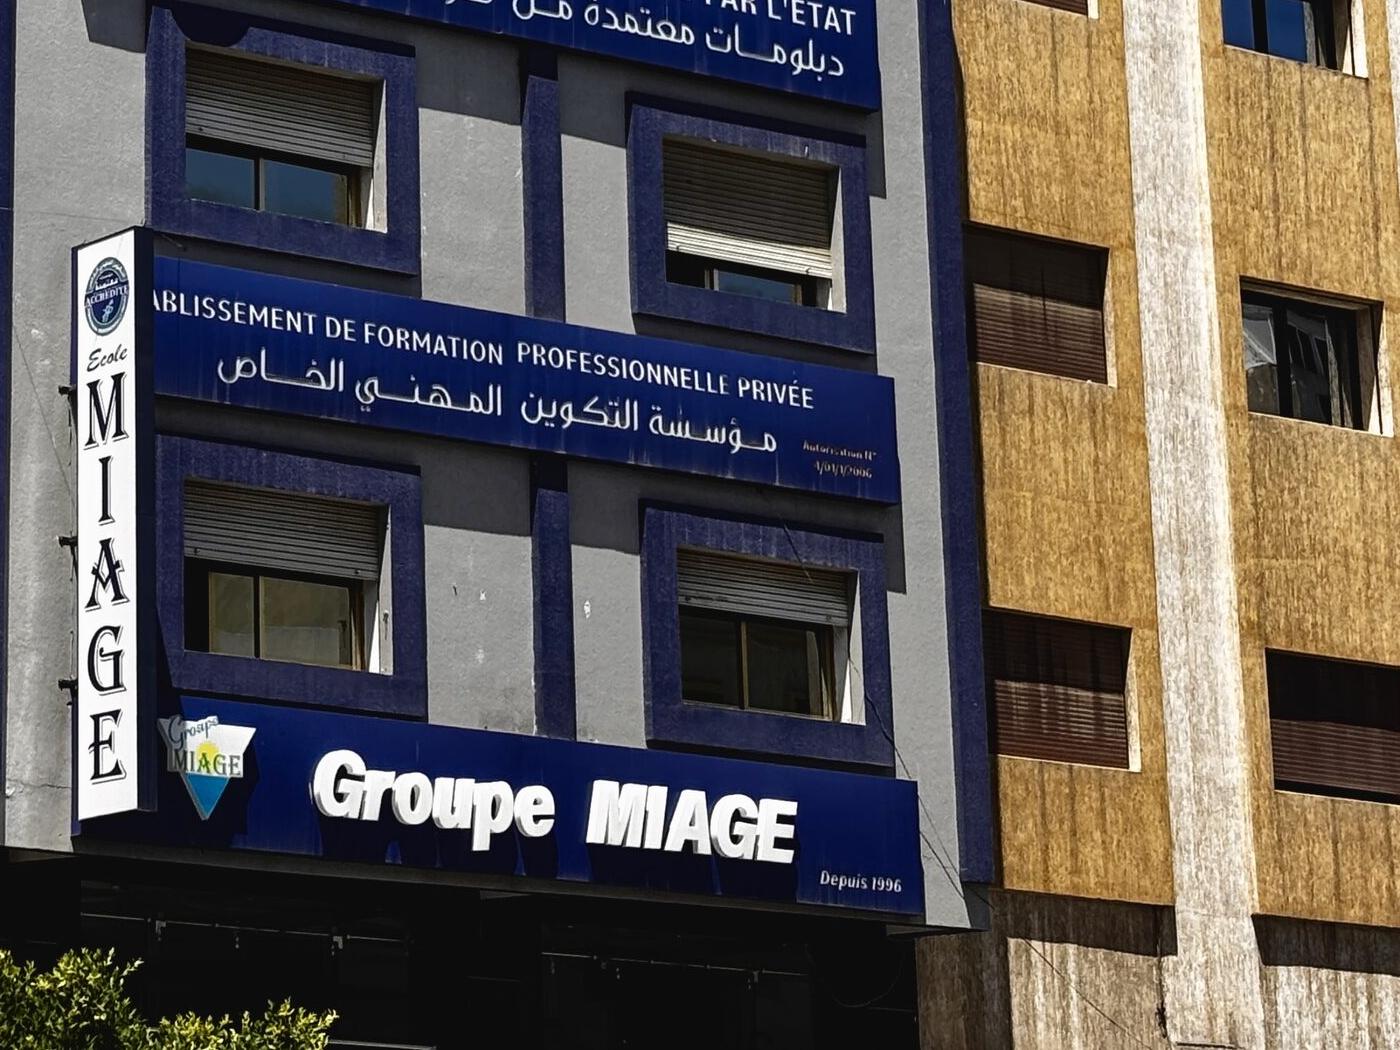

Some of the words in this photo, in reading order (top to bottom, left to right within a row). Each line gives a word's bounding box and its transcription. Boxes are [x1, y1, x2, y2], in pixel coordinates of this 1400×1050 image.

[705, 23, 844, 82] دبلومات
[86, 344, 128, 373] Ecole
[217, 345, 345, 393] الخاص
[325, 316, 356, 342] DE
[364, 322, 503, 366] FORMATION
[516, 341, 730, 396] PROFESSIONNELLE
[738, 376, 814, 410] PRIVÉE
[354, 374, 502, 416] المهني
[520, 388, 640, 432] التكوين
[648, 405, 777, 453] مؤسسة
[83, 371, 130, 785] MIAGE
[173, 750, 241, 776] MIAGE
[313, 749, 555, 851] Groupe
[586, 779, 798, 864] MIAGE
[819, 870, 868, 892] Depuis
[871, 876, 902, 893] 1996
